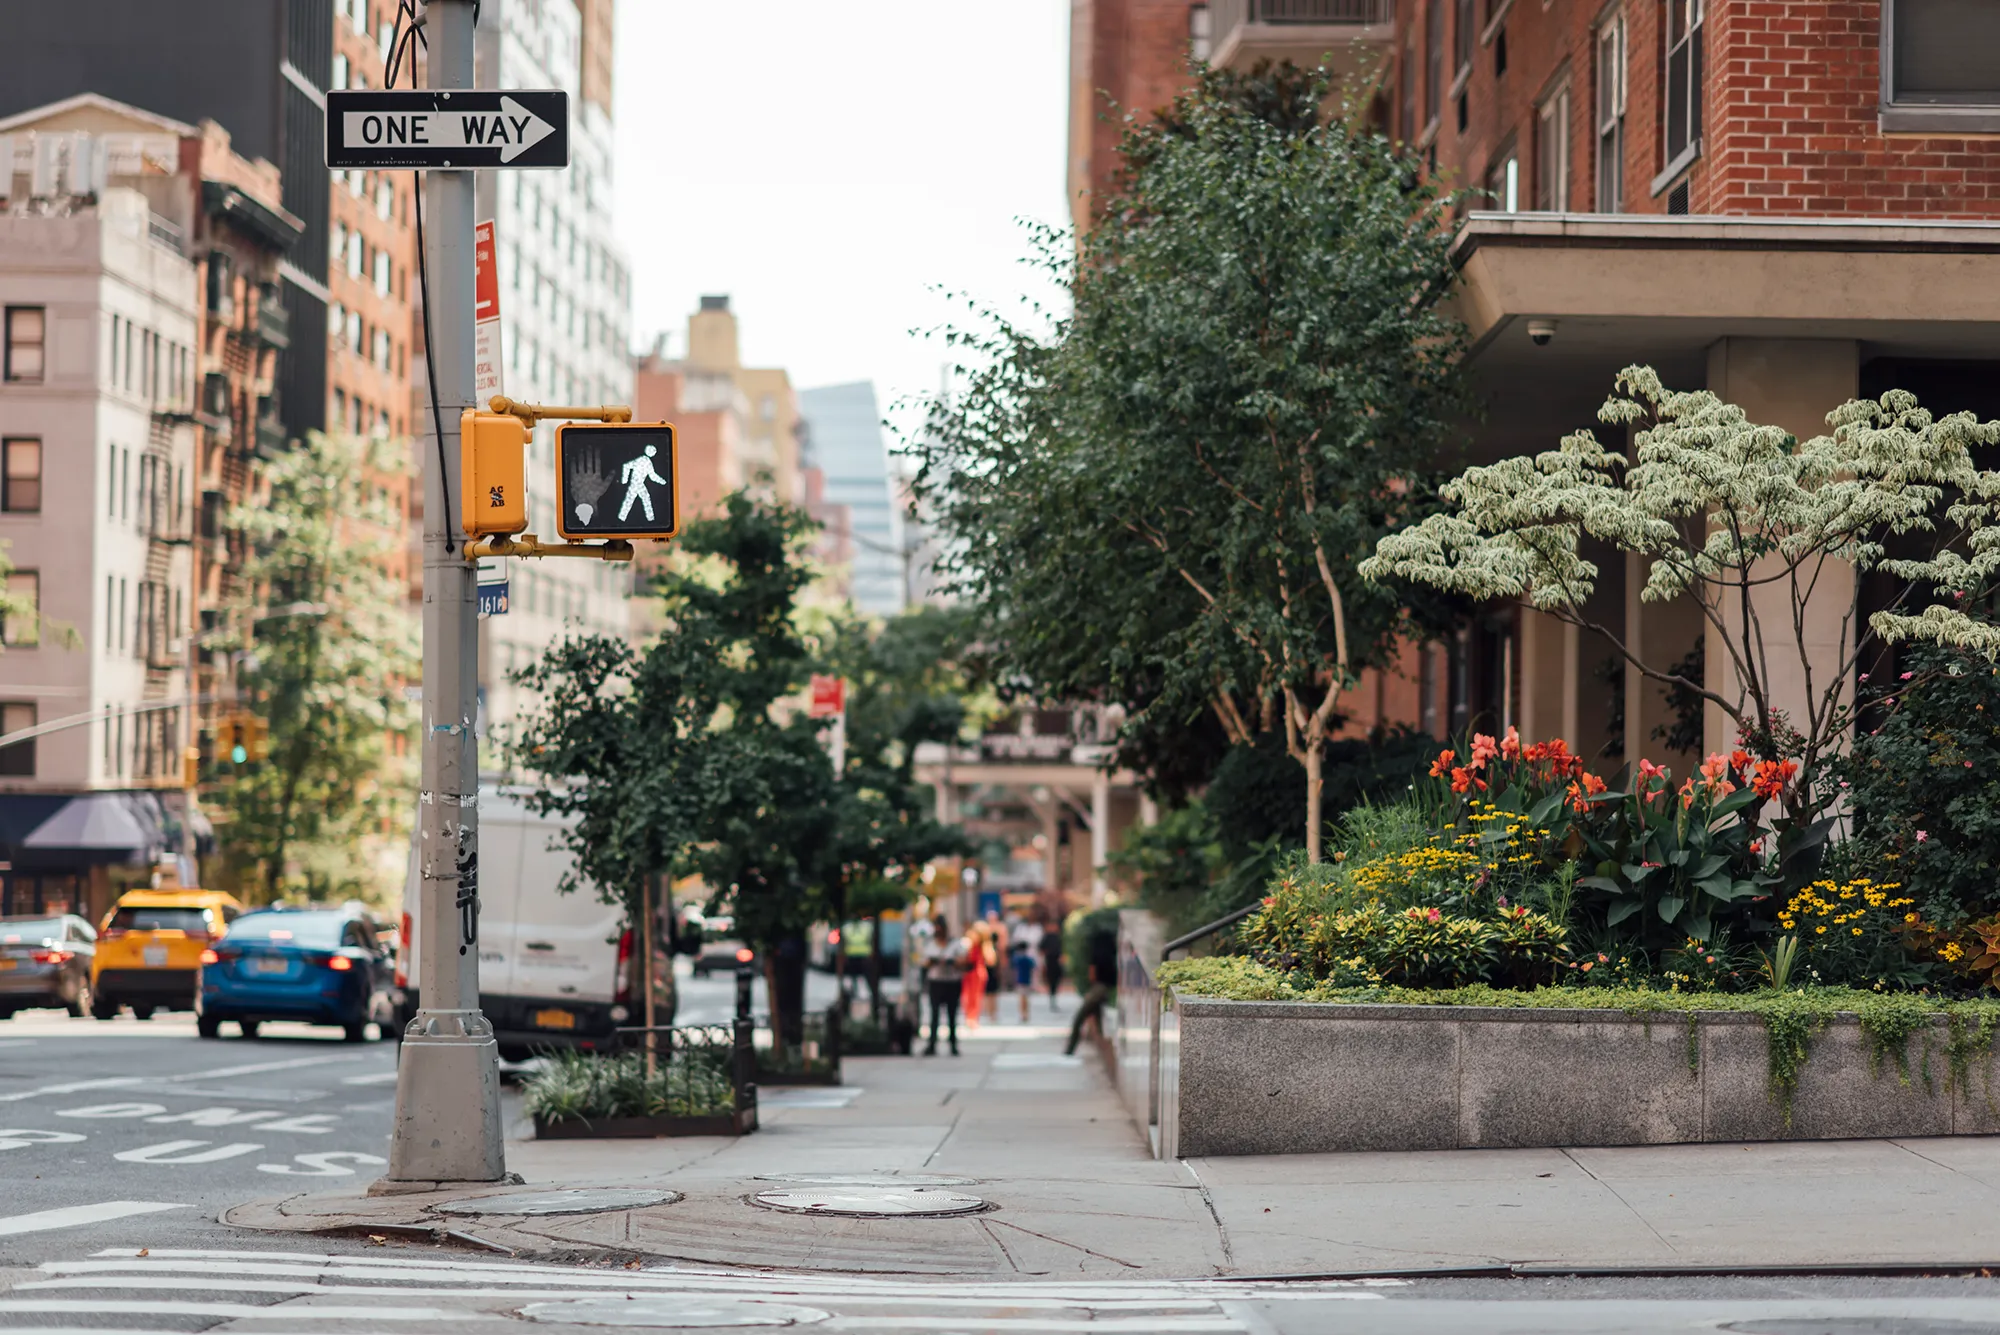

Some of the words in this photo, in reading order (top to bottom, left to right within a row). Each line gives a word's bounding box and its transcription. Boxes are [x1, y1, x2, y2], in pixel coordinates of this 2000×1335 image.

[362, 115, 429, 144] ONE
[461, 115, 532, 144] WAY
[489, 485, 504, 494] AC
[490, 499, 505, 508] AB
[55, 1102, 342, 1134] ONL
